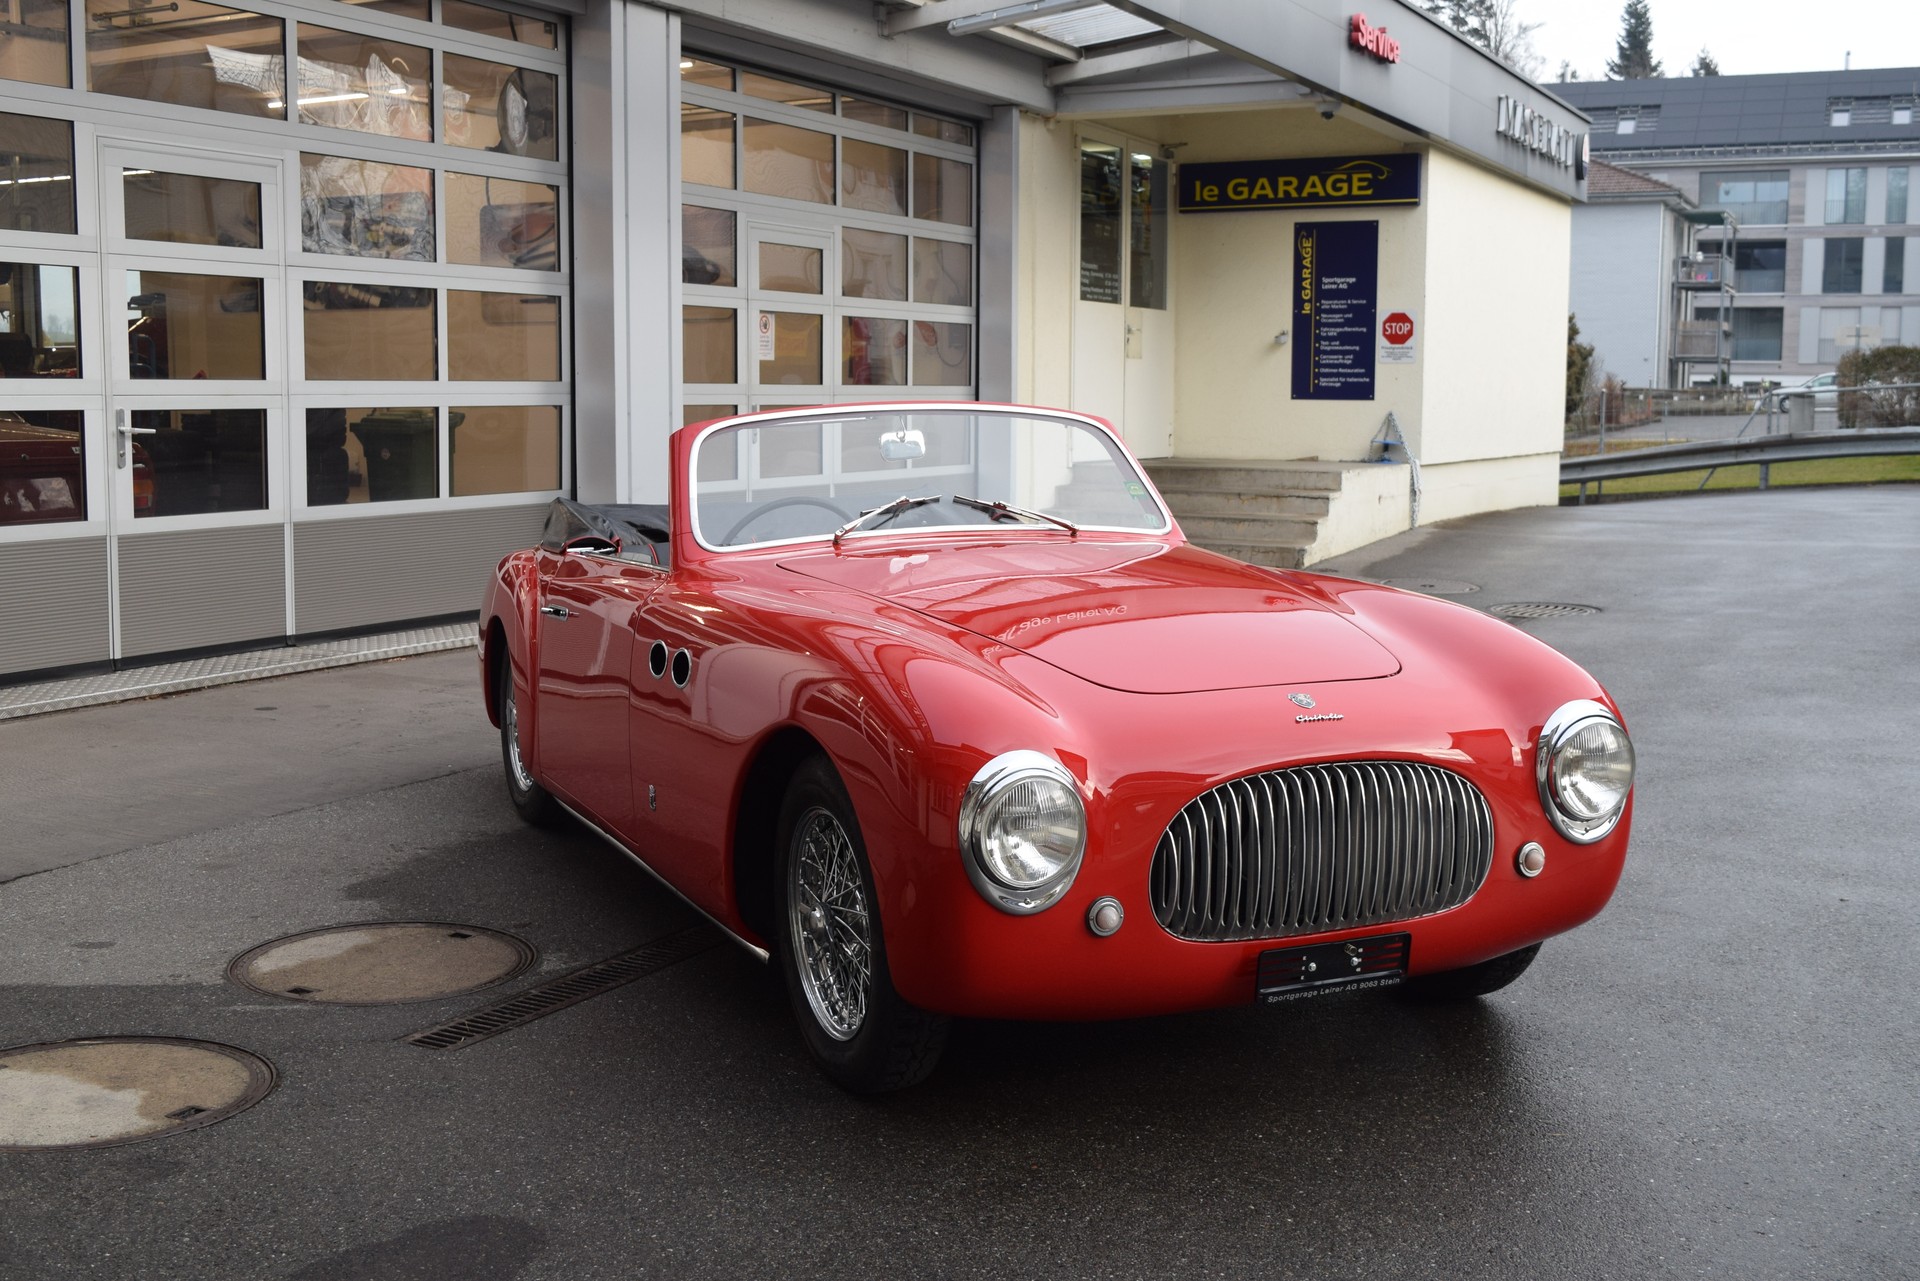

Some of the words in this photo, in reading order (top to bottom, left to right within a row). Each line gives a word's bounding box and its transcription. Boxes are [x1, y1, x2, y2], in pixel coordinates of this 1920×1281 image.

[1351, 12, 1400, 63] Service
[1497, 94, 1575, 167] MASERATI
[1195, 180, 1219, 201] le
[1227, 173, 1373, 200] GARAGE
[1302, 237, 1312, 300] GARAGE
[1302, 302, 1311, 313] le
[1385, 322, 1411, 335] STOP
[1267, 990, 1318, 1003] Sportgarage
[1320, 986, 1343, 995] Leirer
[1345, 983, 1358, 991] AG
[1359, 980, 1378, 989] 9063
[1380, 978, 1400, 986] Stein
